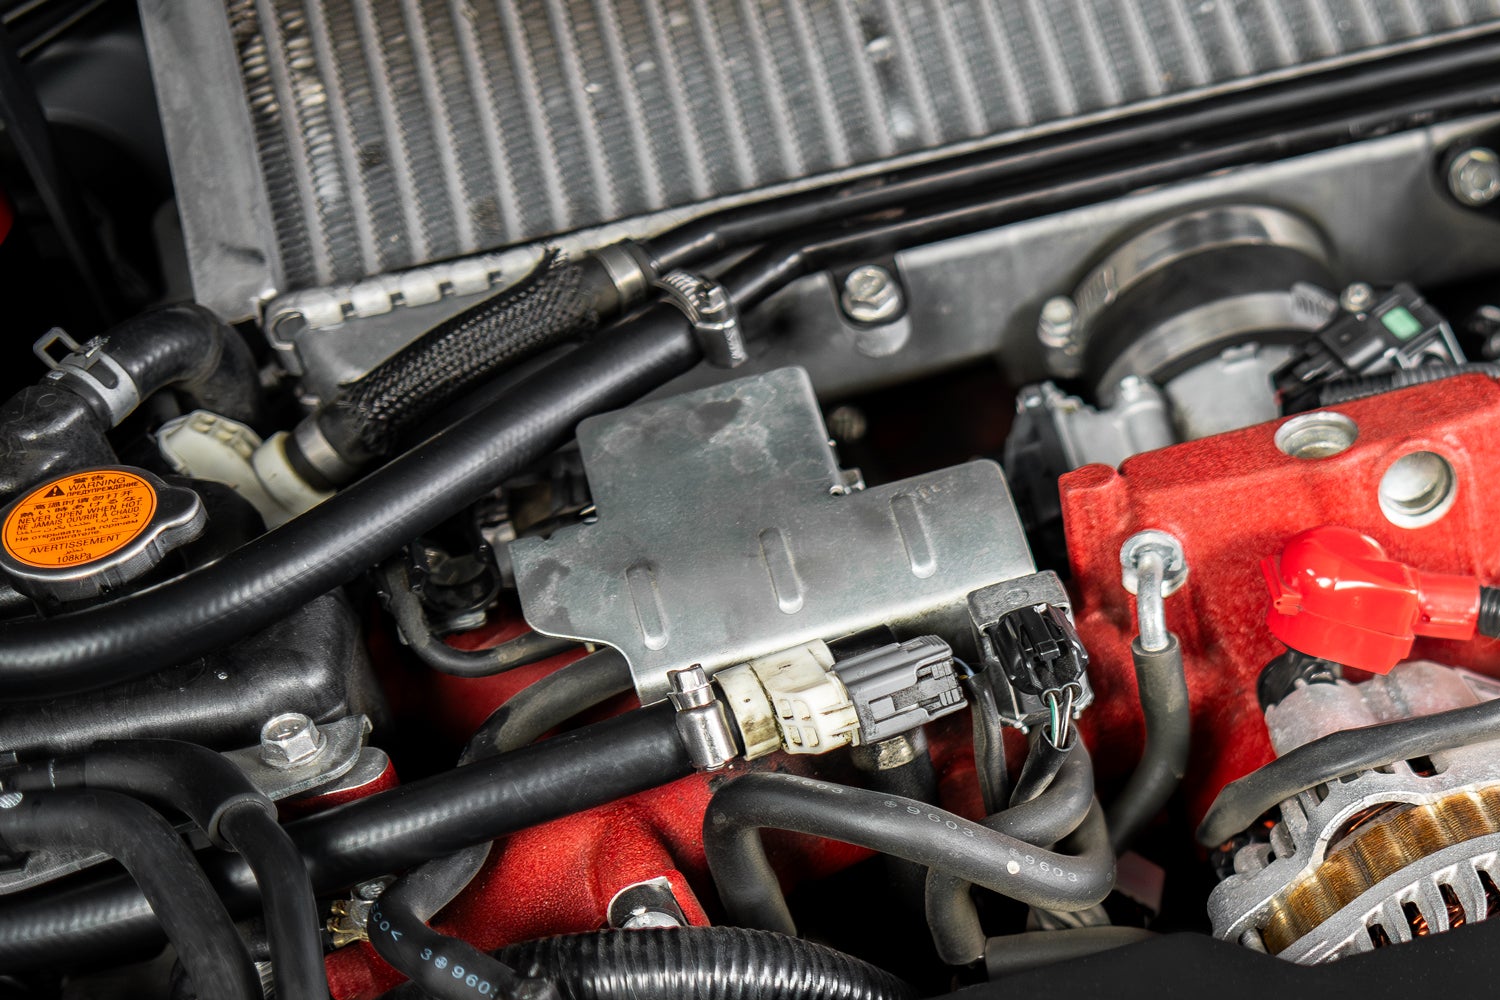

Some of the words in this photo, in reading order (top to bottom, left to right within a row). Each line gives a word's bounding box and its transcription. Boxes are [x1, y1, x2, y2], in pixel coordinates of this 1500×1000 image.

[68, 477, 125, 491] WARNING
[18, 515, 51, 524] NEVER
[56, 510, 82, 520] OPEN
[87, 505, 117, 514] WHEN
[31, 519, 62, 528] JAMAIS
[66, 514, 98, 523] OUVRIR
[29, 534, 120, 554] AVERTISSEMENT
[57, 552, 92, 563] 108kPa
[906, 804, 975, 838] 9603
[1024, 853, 1079, 883] 9603
[420, 948, 433, 961] 3
[451, 964, 498, 998] 960
